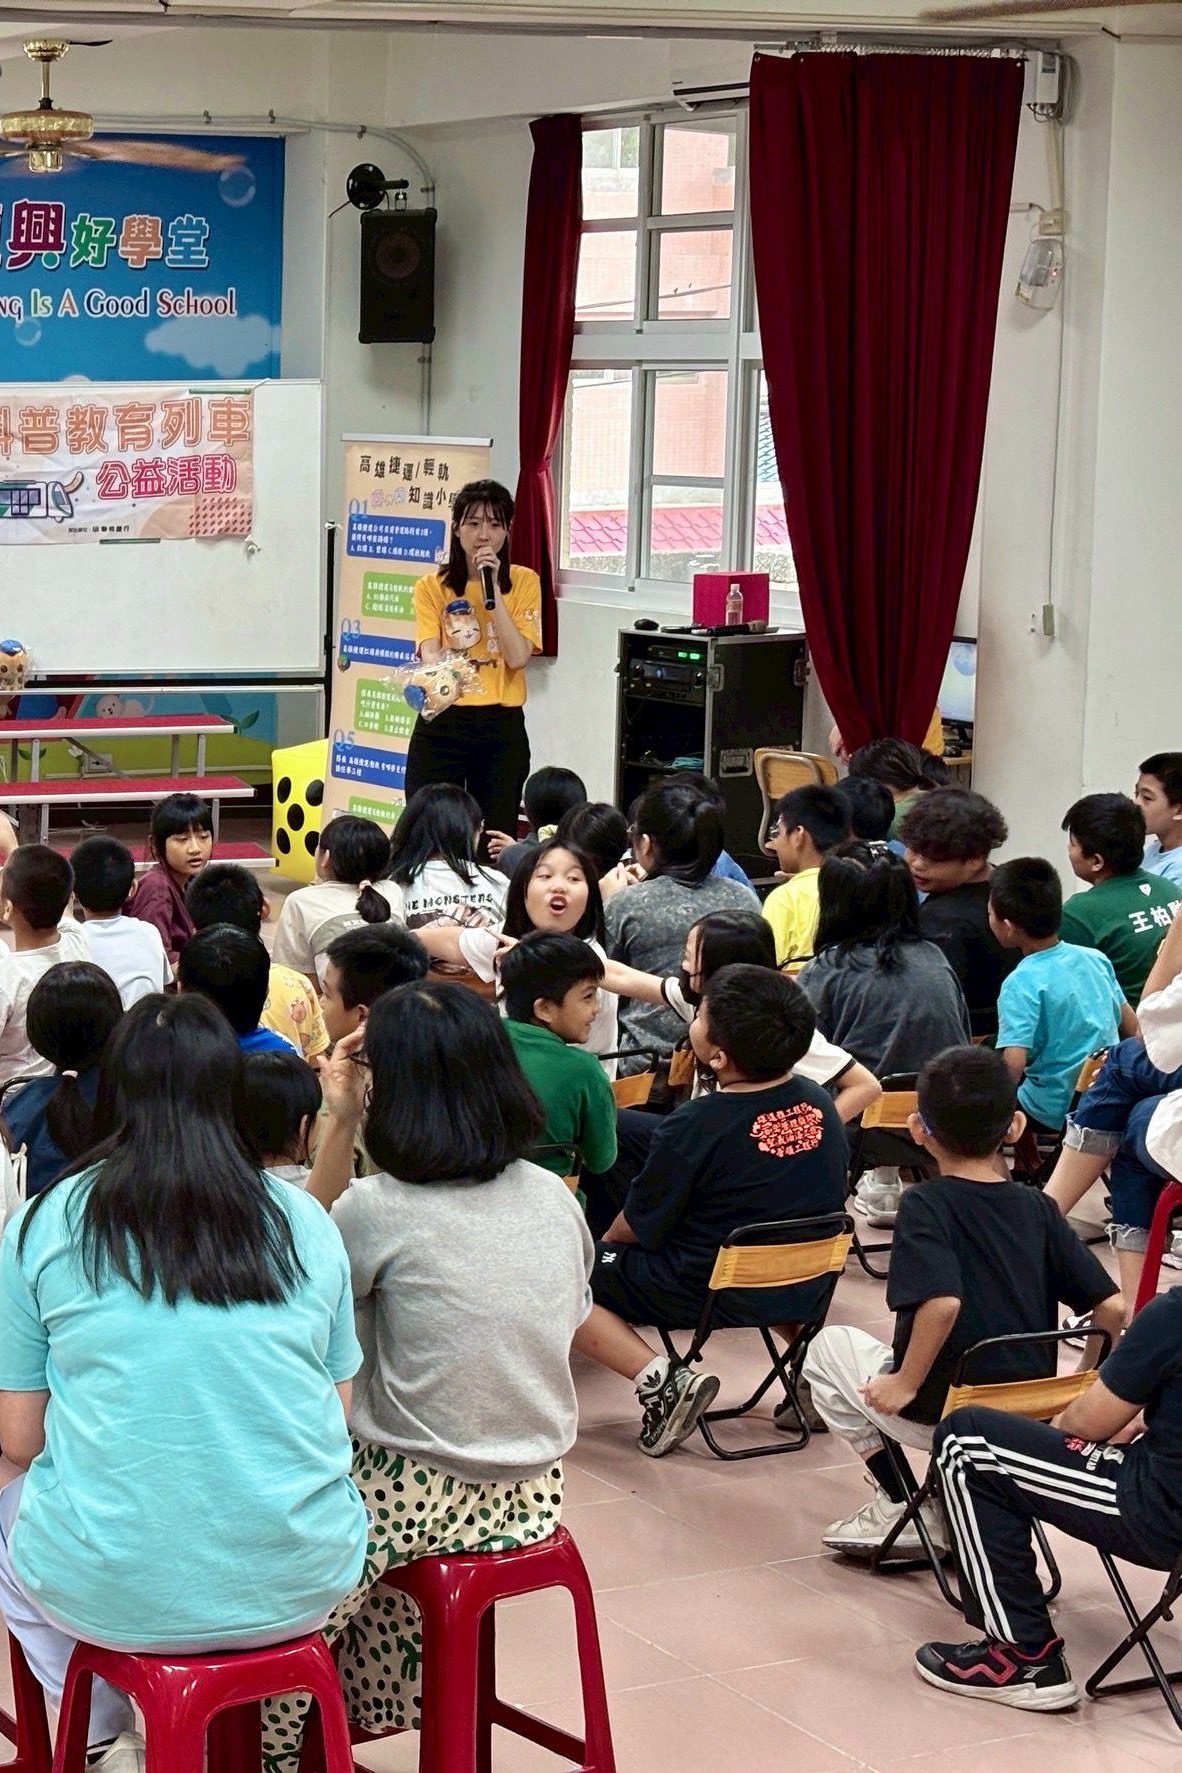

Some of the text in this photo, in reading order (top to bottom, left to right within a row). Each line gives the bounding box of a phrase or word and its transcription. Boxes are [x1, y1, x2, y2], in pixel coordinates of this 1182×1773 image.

[31, 288, 51, 318] Is
[58, 289, 79, 318] A
[85, 288, 149, 318] Good
[156, 287, 238, 318] School
[96, 454, 238, 499] 公益活動
[359, 455, 450, 482] 高雄捷運/輕軌
[423, 892, 494, 908] MONSTERS
